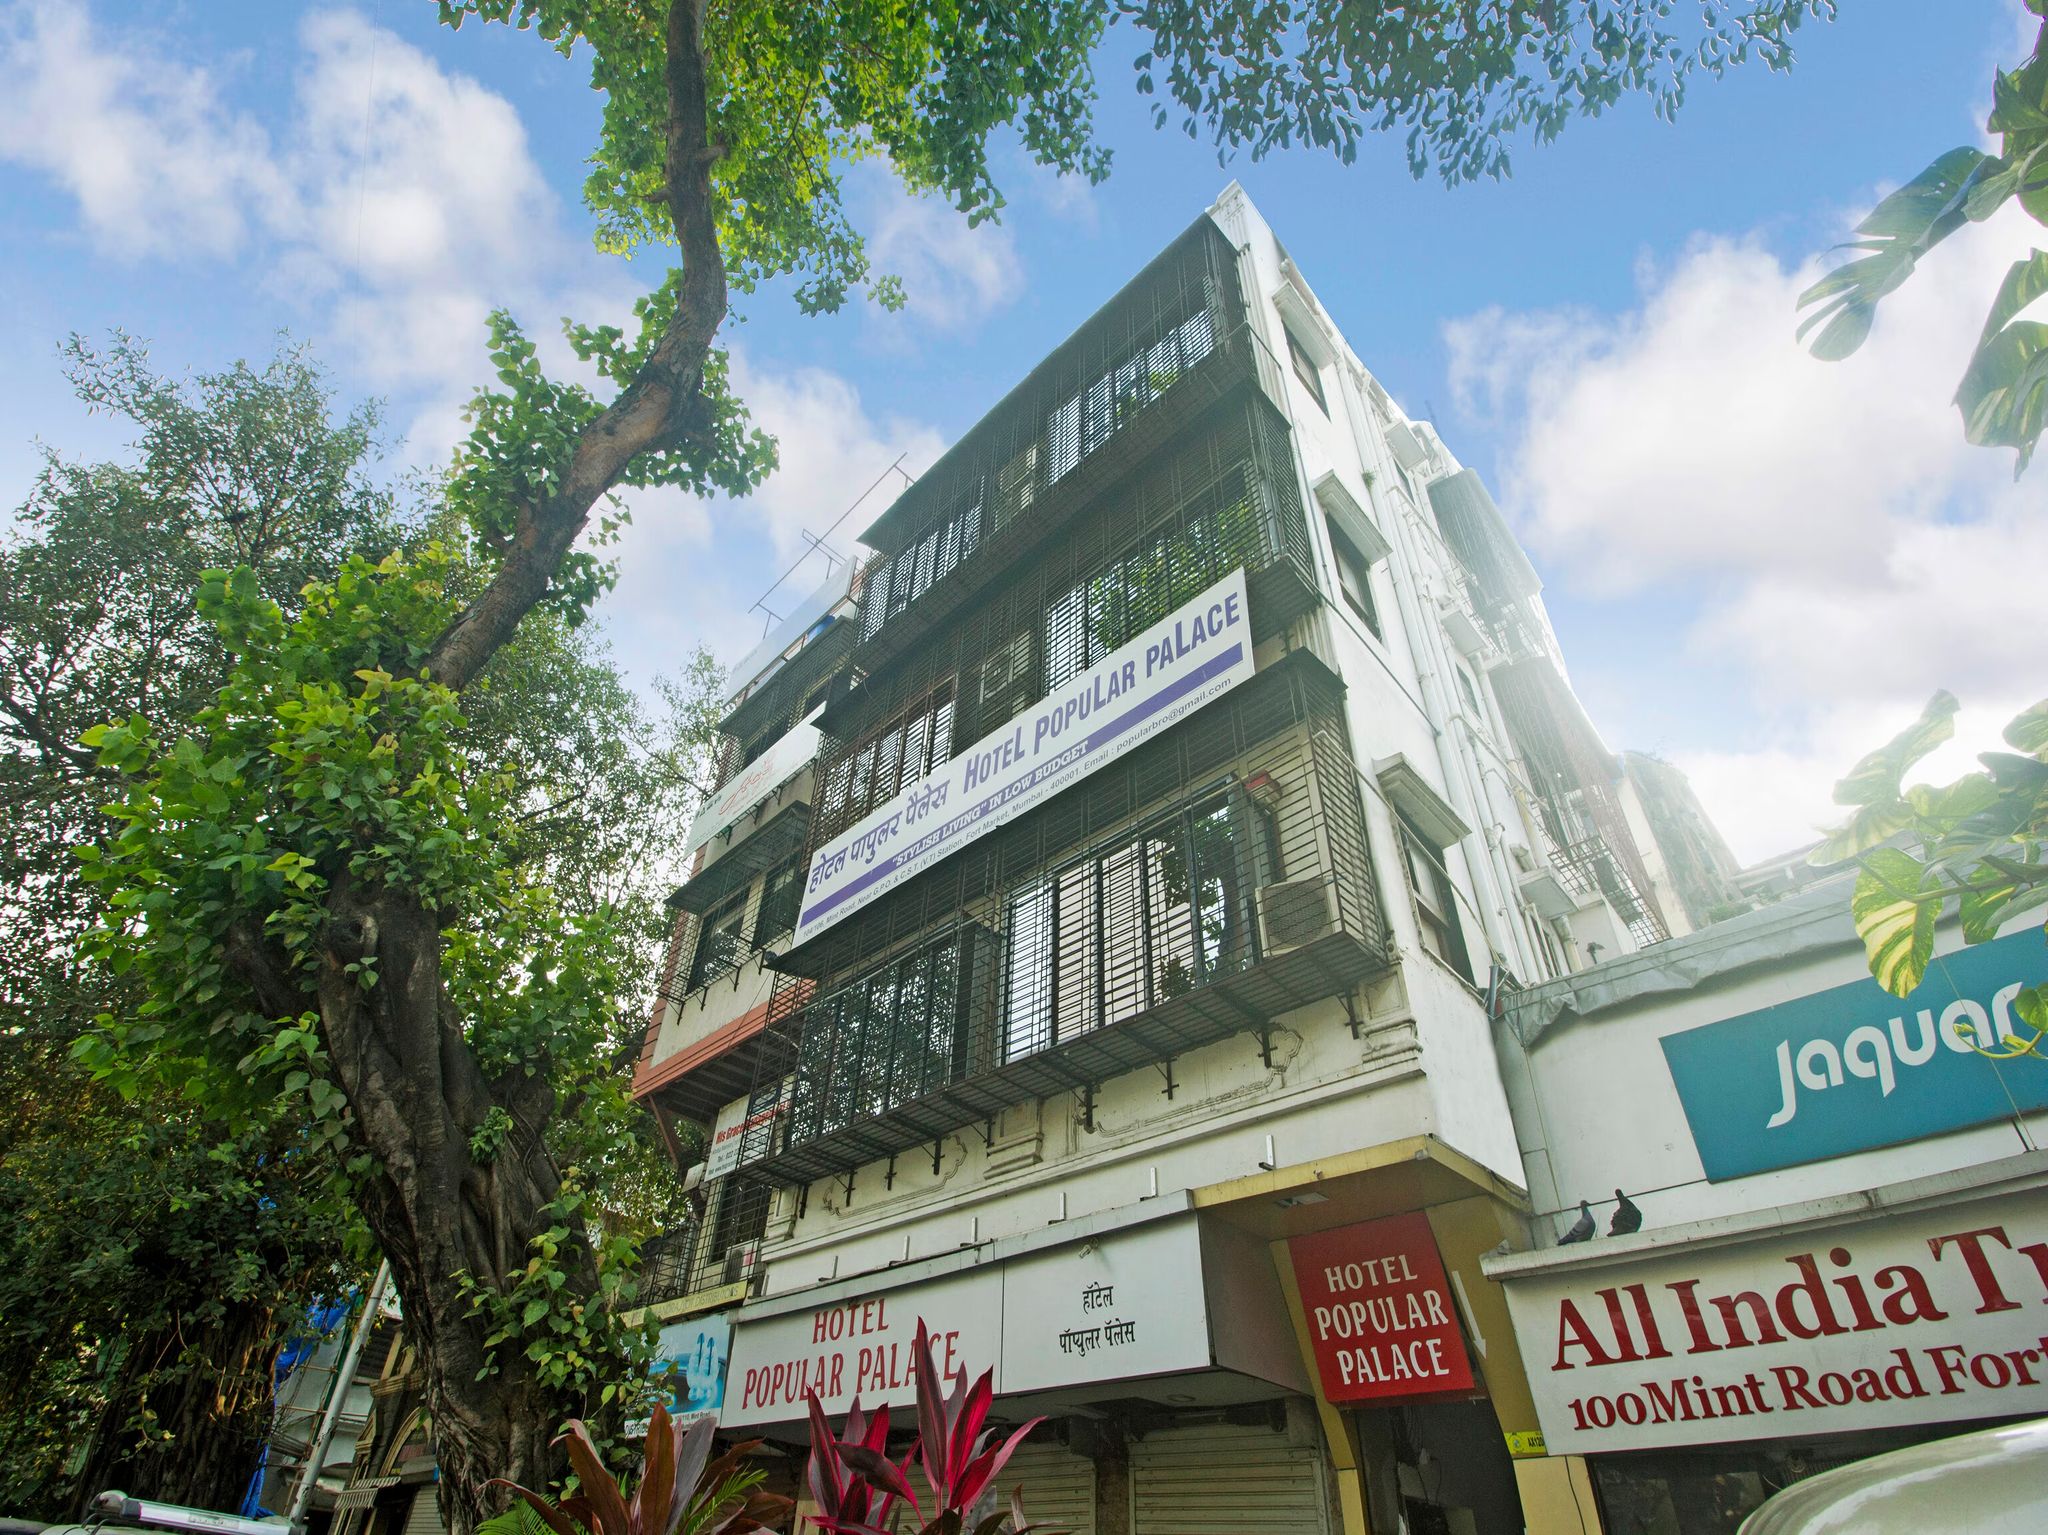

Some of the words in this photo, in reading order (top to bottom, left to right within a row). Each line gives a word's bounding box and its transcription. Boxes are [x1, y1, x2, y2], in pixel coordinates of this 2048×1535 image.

[963, 726, 1025, 794] HOTEL
[1034, 660, 1135, 755] POPULAR
[1146, 592, 1240, 678] PALACE
[857, 891, 873, 905] Near
[893, 875, 899, 883] &
[965, 826, 982, 841] Fort
[1012, 790, 1044, 813] Mumbai
[1084, 751, 1110, 771] Email
[1116, 678, 1231, 753] popularbro@gmail.com
[989, 793, 1002, 811] IN
[1004, 774, 1035, 799] LOW
[1035, 740, 1088, 783] BUDGET
[1082, 1281, 1114, 1315] हॉटेल
[1324, 1254, 1418, 1292] HOTEL
[812, 1298, 889, 1344] HOTEL
[1314, 1289, 1449, 1341] POPULAR
[1551, 1283, 1673, 1371] All
[1665, 1247, 1949, 1354] India
[742, 1353, 844, 1410] POPULAR
[1336, 1338, 1450, 1385] PALACE
[1769, 1347, 1930, 1411] Road
